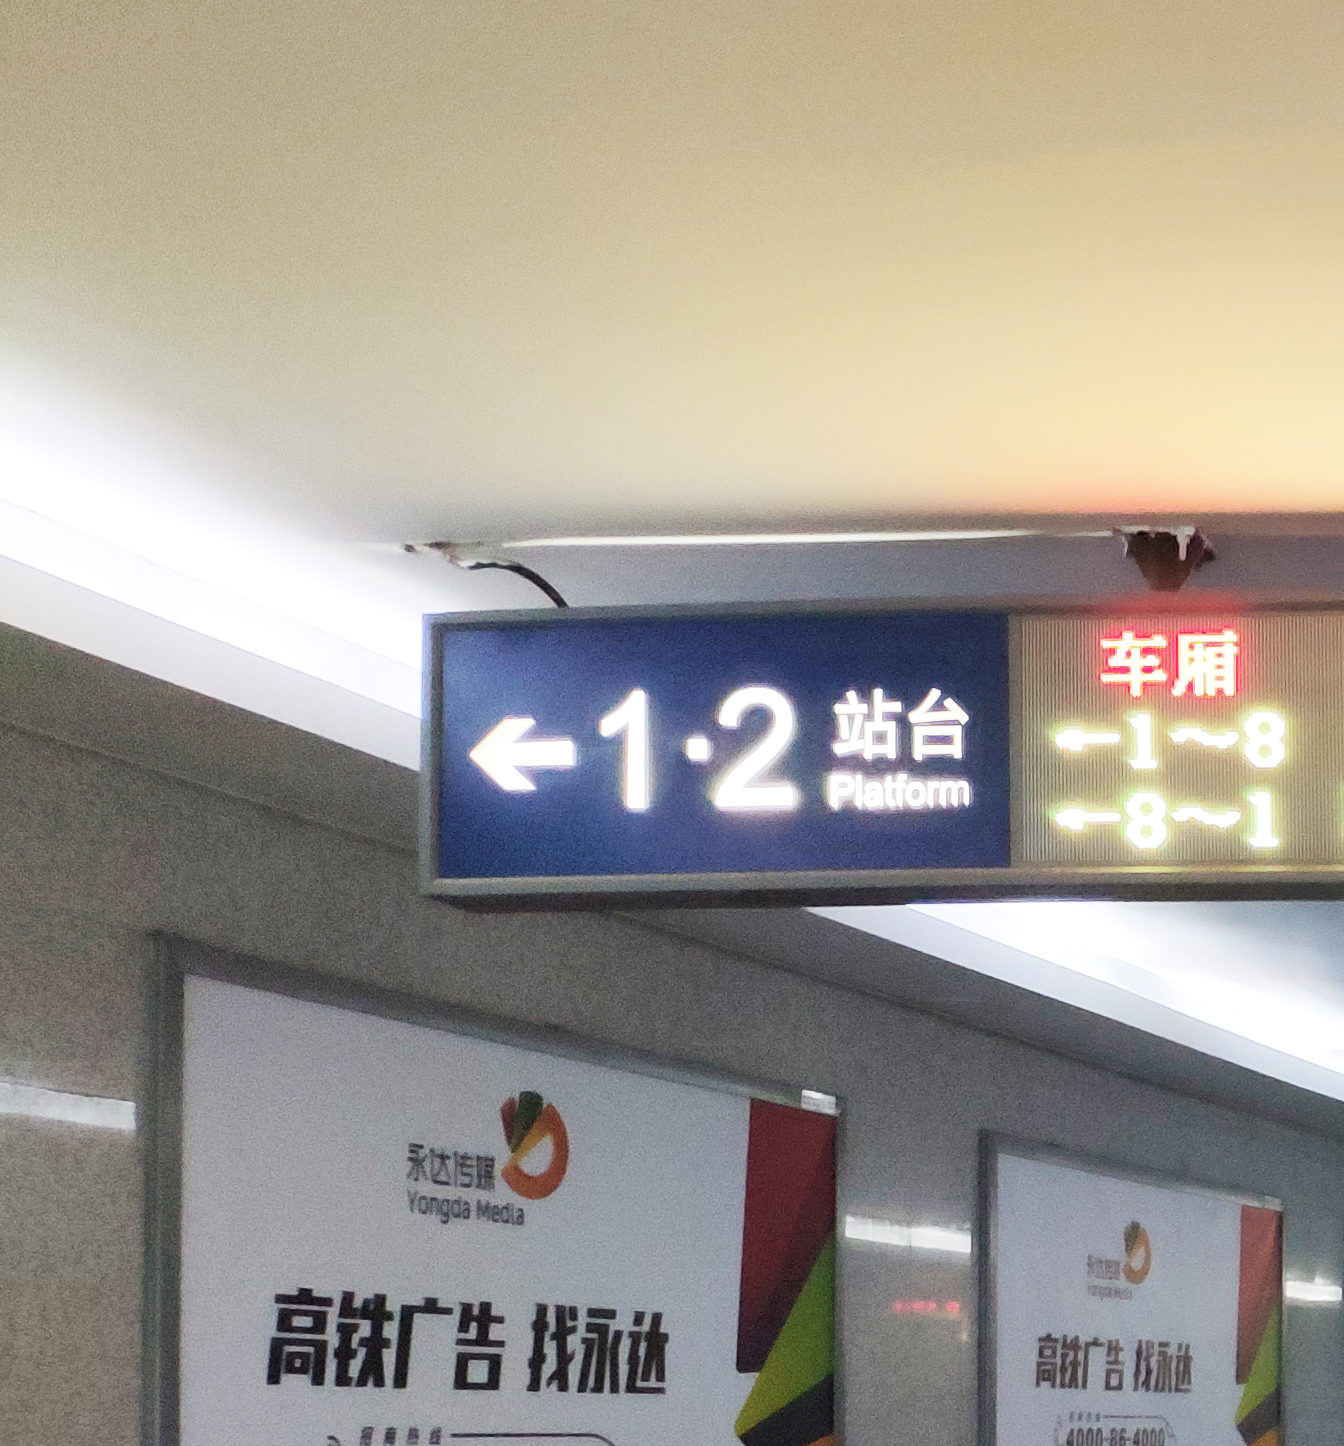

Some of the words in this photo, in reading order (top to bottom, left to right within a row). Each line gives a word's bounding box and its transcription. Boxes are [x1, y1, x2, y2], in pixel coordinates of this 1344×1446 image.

[1100, 631, 1240, 697] 车厢
[831, 688, 970, 762] 站台
[827, 772, 971, 812] Platform
[407, 1189, 470, 1224] Yongda
[477, 1199, 524, 1226] Media
[267, 1287, 506, 1390] 高铁广告
[526, 1303, 669, 1394] 找永达
[1035, 1333, 1125, 1391] 高铁广告
[1132, 1339, 1194, 1394] 找永达
